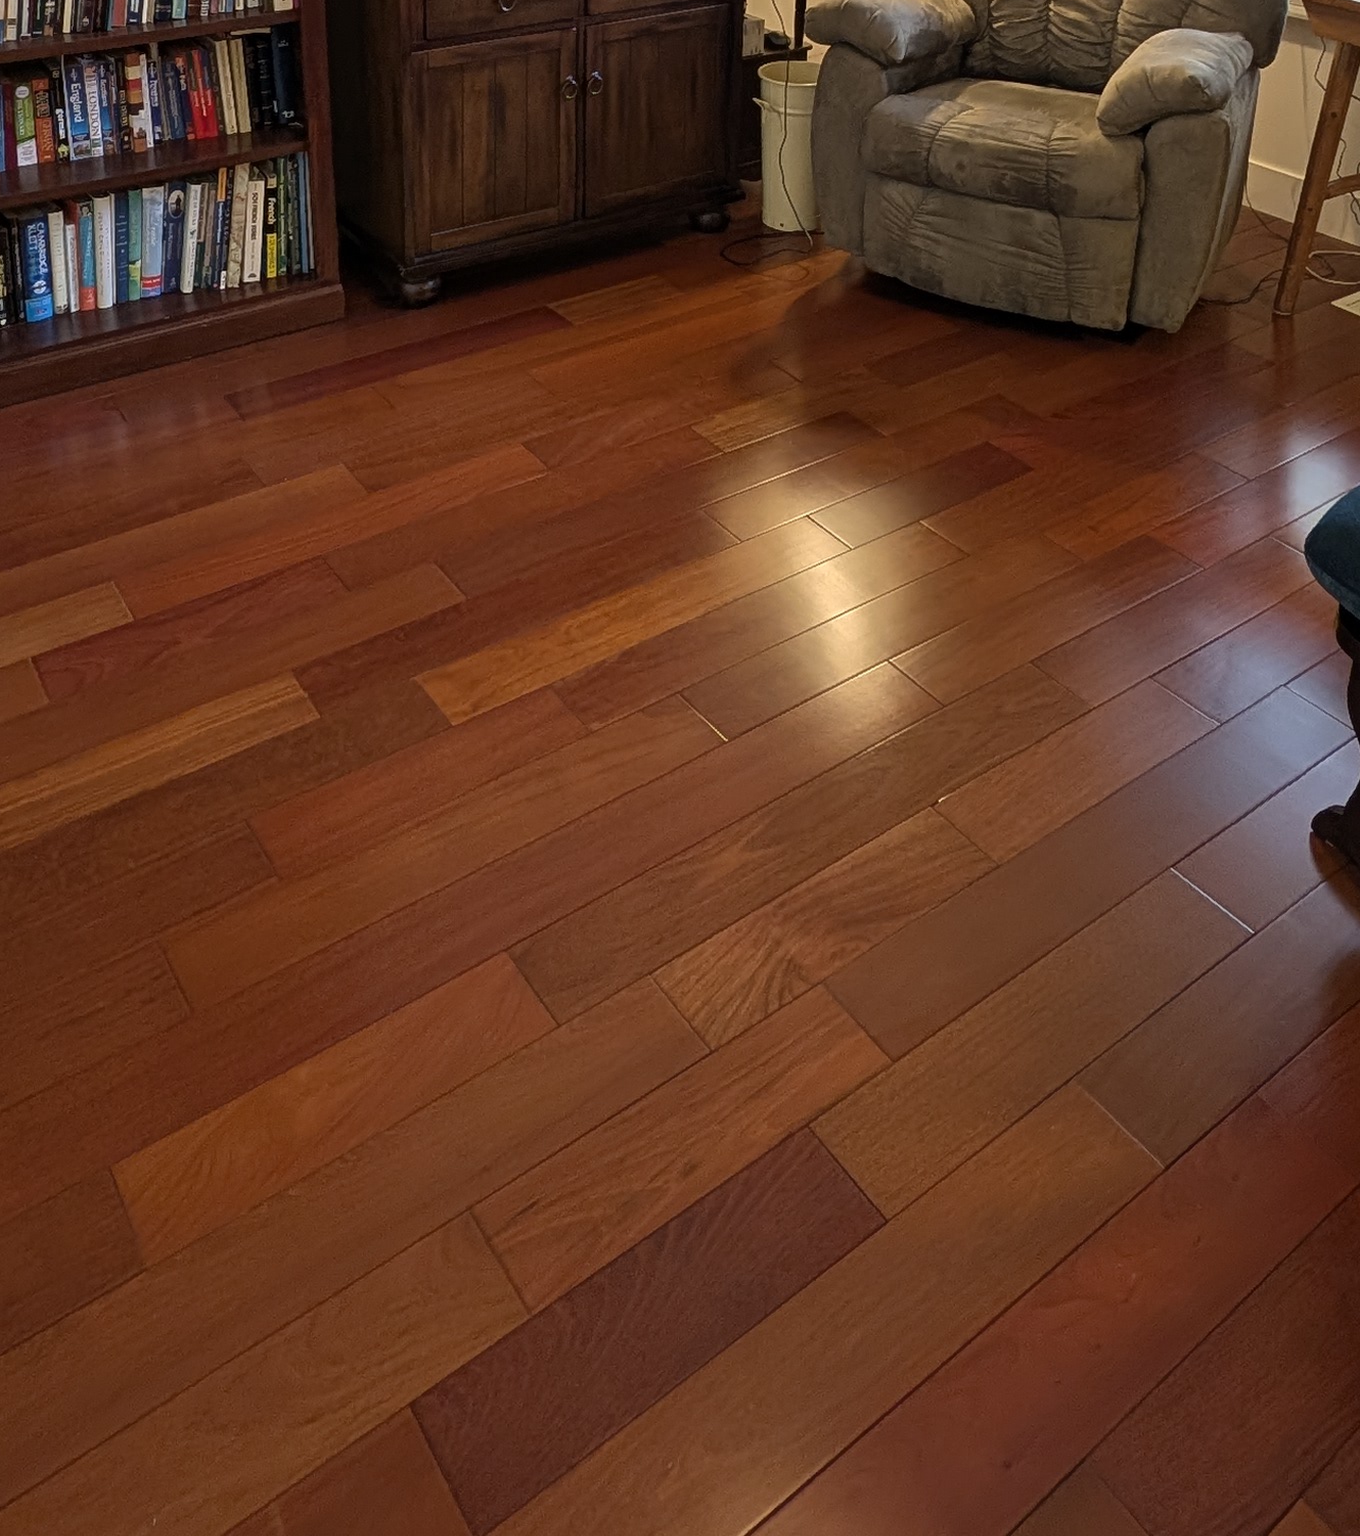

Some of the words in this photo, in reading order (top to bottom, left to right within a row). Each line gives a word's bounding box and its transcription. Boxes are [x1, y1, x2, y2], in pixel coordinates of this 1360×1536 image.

[70, 82, 84, 122] England
[88, 90, 99, 138] LONDON
[267, 197, 277, 225] French
